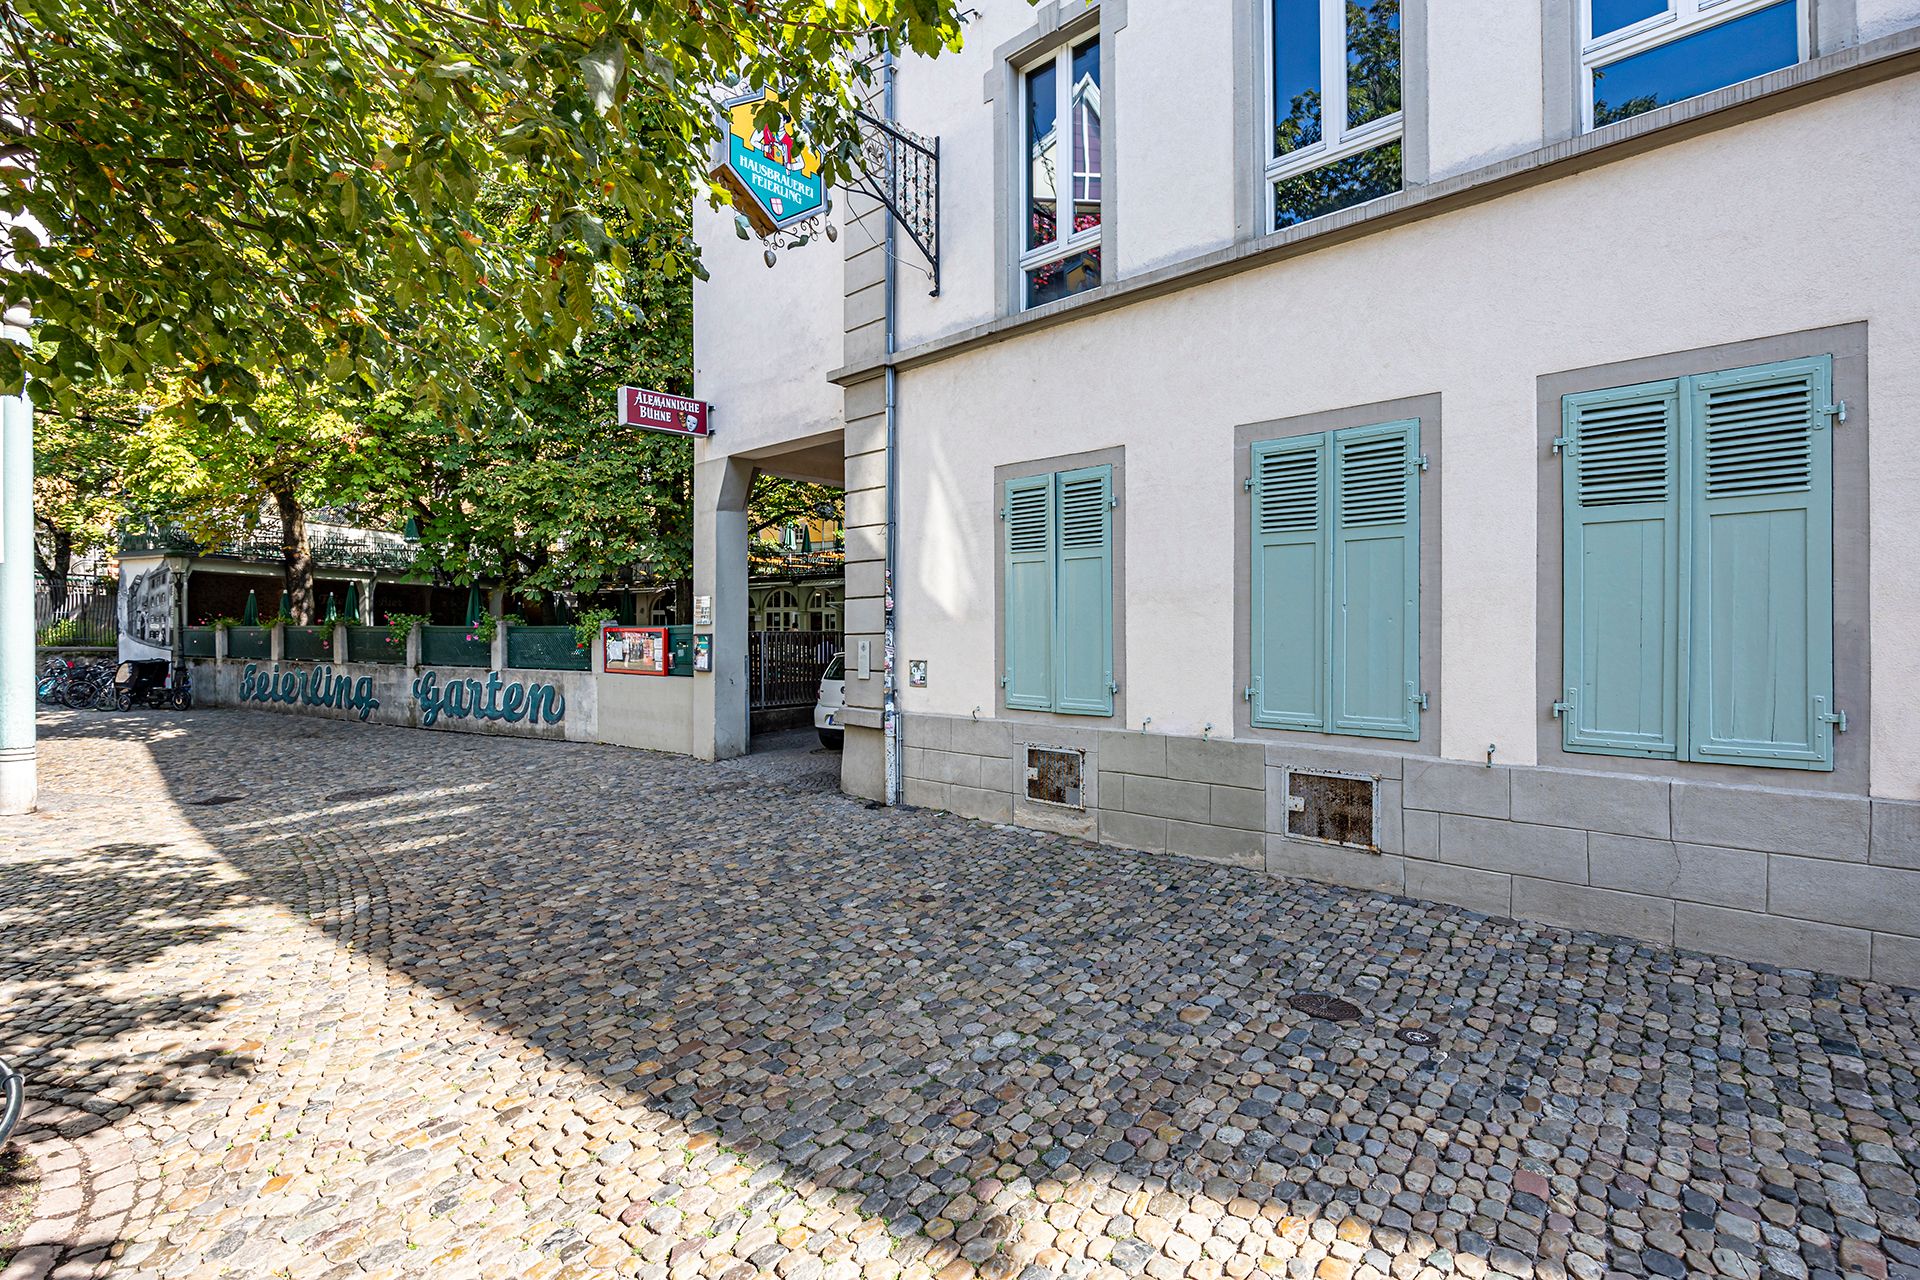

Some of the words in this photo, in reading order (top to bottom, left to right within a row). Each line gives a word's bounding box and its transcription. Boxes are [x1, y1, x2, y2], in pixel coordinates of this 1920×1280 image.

[739, 155, 814, 198] HAUSBRAUEREI
[752, 173, 802, 205] FEIERLING
[634, 391, 700, 413] ALEMANNISCHE
[239, 663, 380, 721] Feierling
[413, 671, 566, 726] Garten
